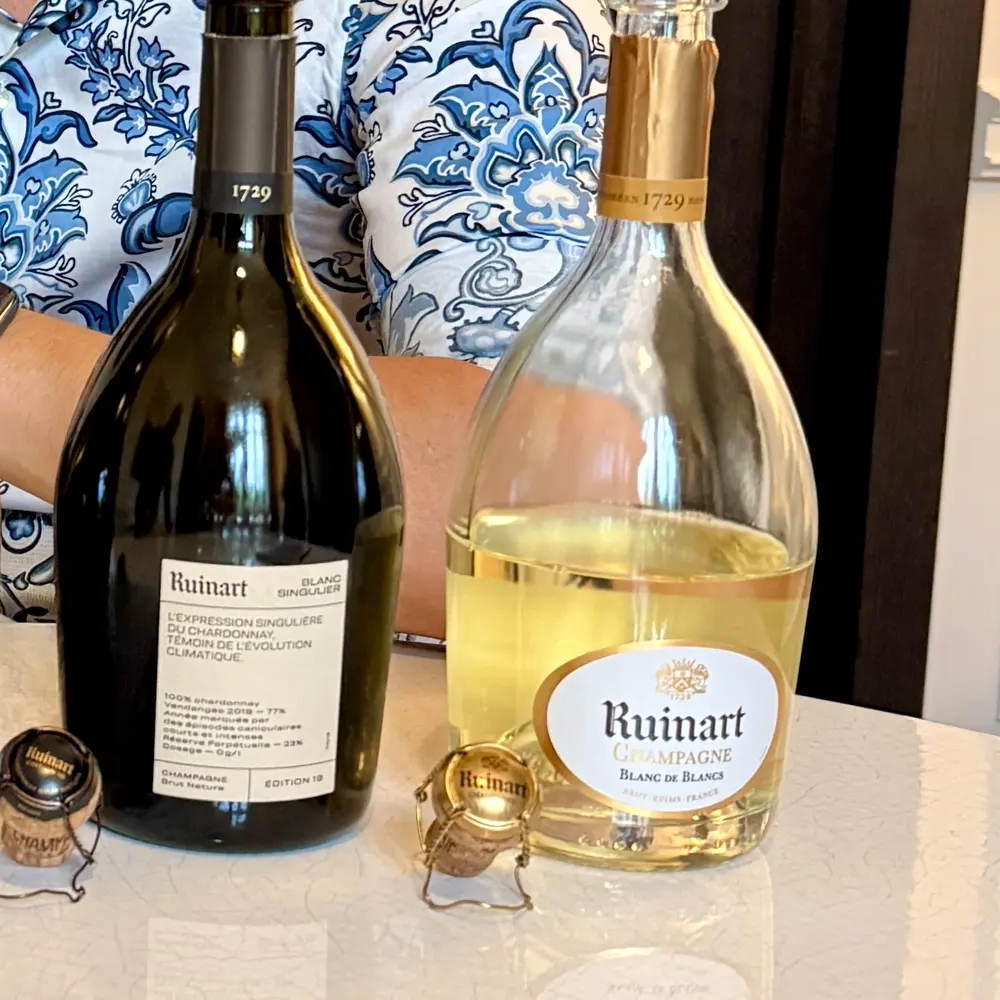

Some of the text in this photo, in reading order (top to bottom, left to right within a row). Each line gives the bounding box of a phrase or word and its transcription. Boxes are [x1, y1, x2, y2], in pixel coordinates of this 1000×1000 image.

[231, 184, 272, 203] 1729
[643, 192, 685, 212] 1729
[170, 570, 248, 598] Ruinart
[301, 574, 342, 587] BLANC
[277, 584, 341, 598] SINGULIER
[167, 612, 253, 628] L'EXPRESSION
[167, 623, 185, 634] DU
[217, 639, 233, 650] DE
[164, 692, 260, 708] 100% chardonnay
[602, 700, 746, 742] Ruinart
[162, 742, 203, 755] Dosage
[161, 769, 229, 784] CHAMPAGNE
[161, 778, 226, 792] Brut Nature
[460, 770, 527, 799] Ruinart
[686, 788, 720, 802] FRANCE
